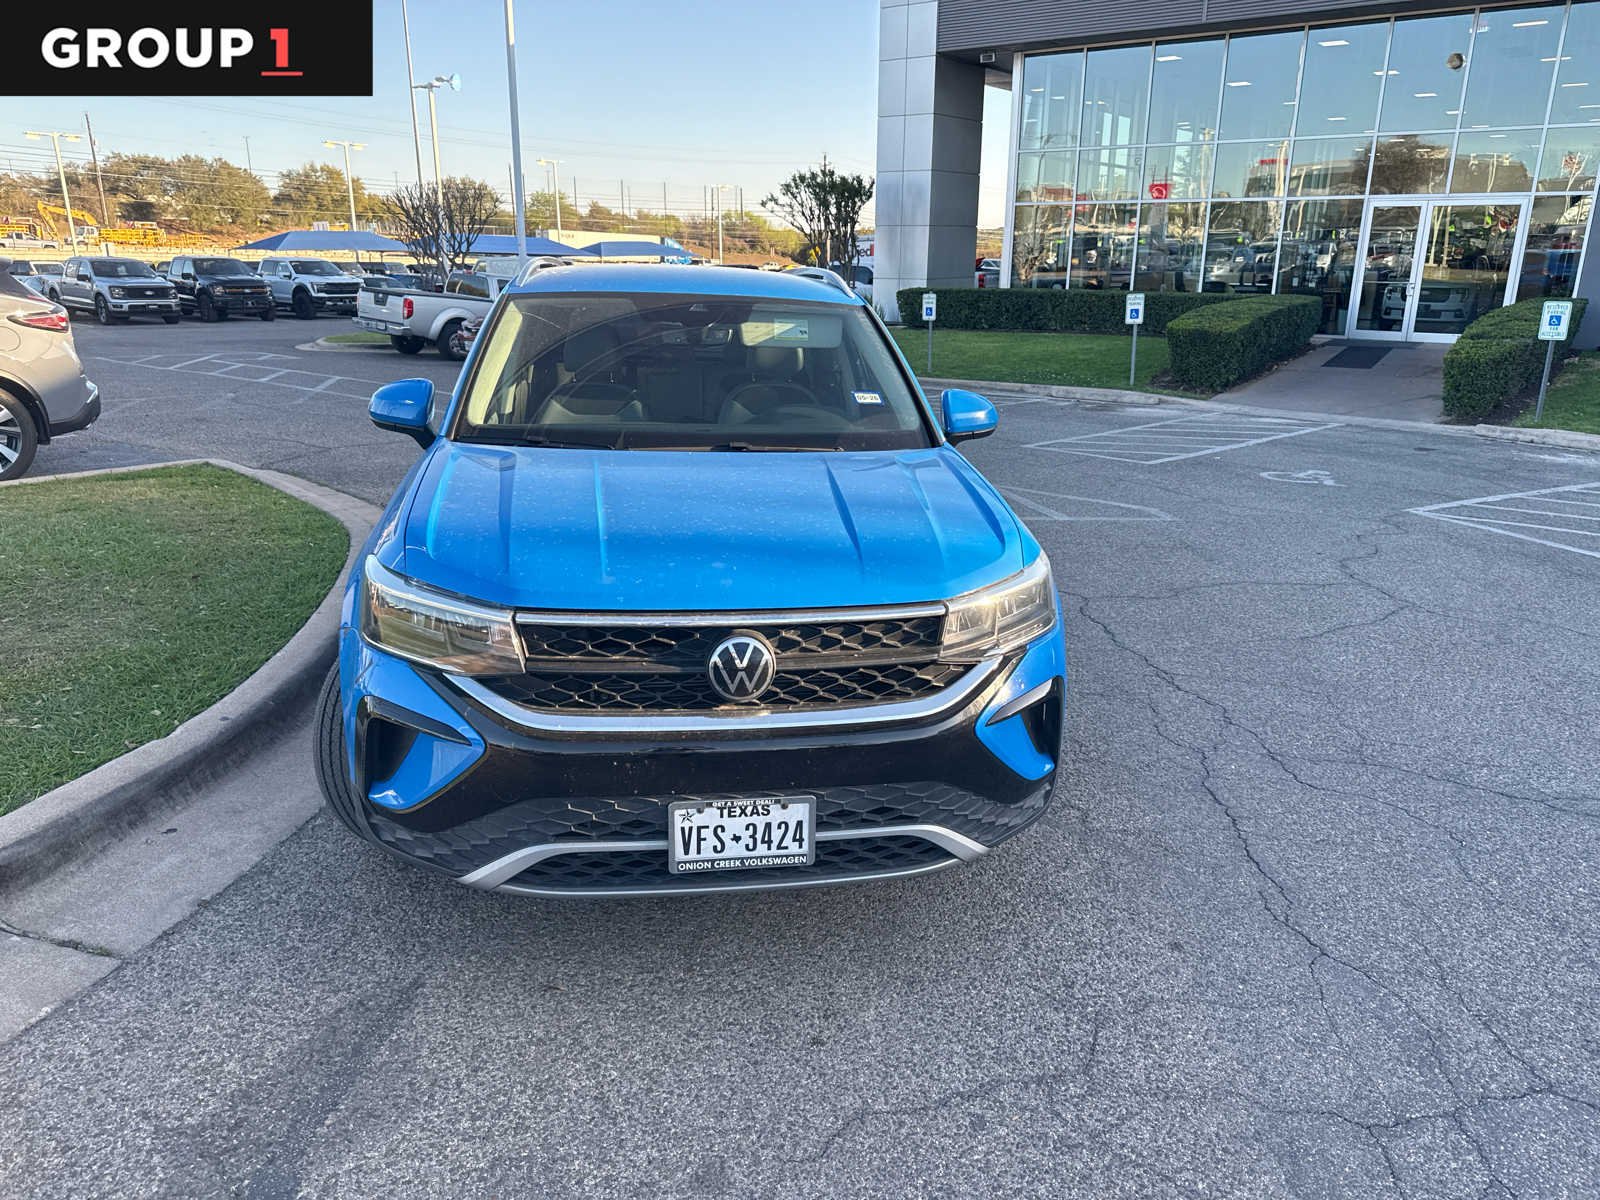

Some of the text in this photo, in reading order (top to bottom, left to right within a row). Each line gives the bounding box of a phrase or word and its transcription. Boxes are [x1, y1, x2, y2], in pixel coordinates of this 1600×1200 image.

[716, 804, 771, 818] TEXAS
[678, 856, 807, 871] ONION CREEK VOLKSWAGEN
